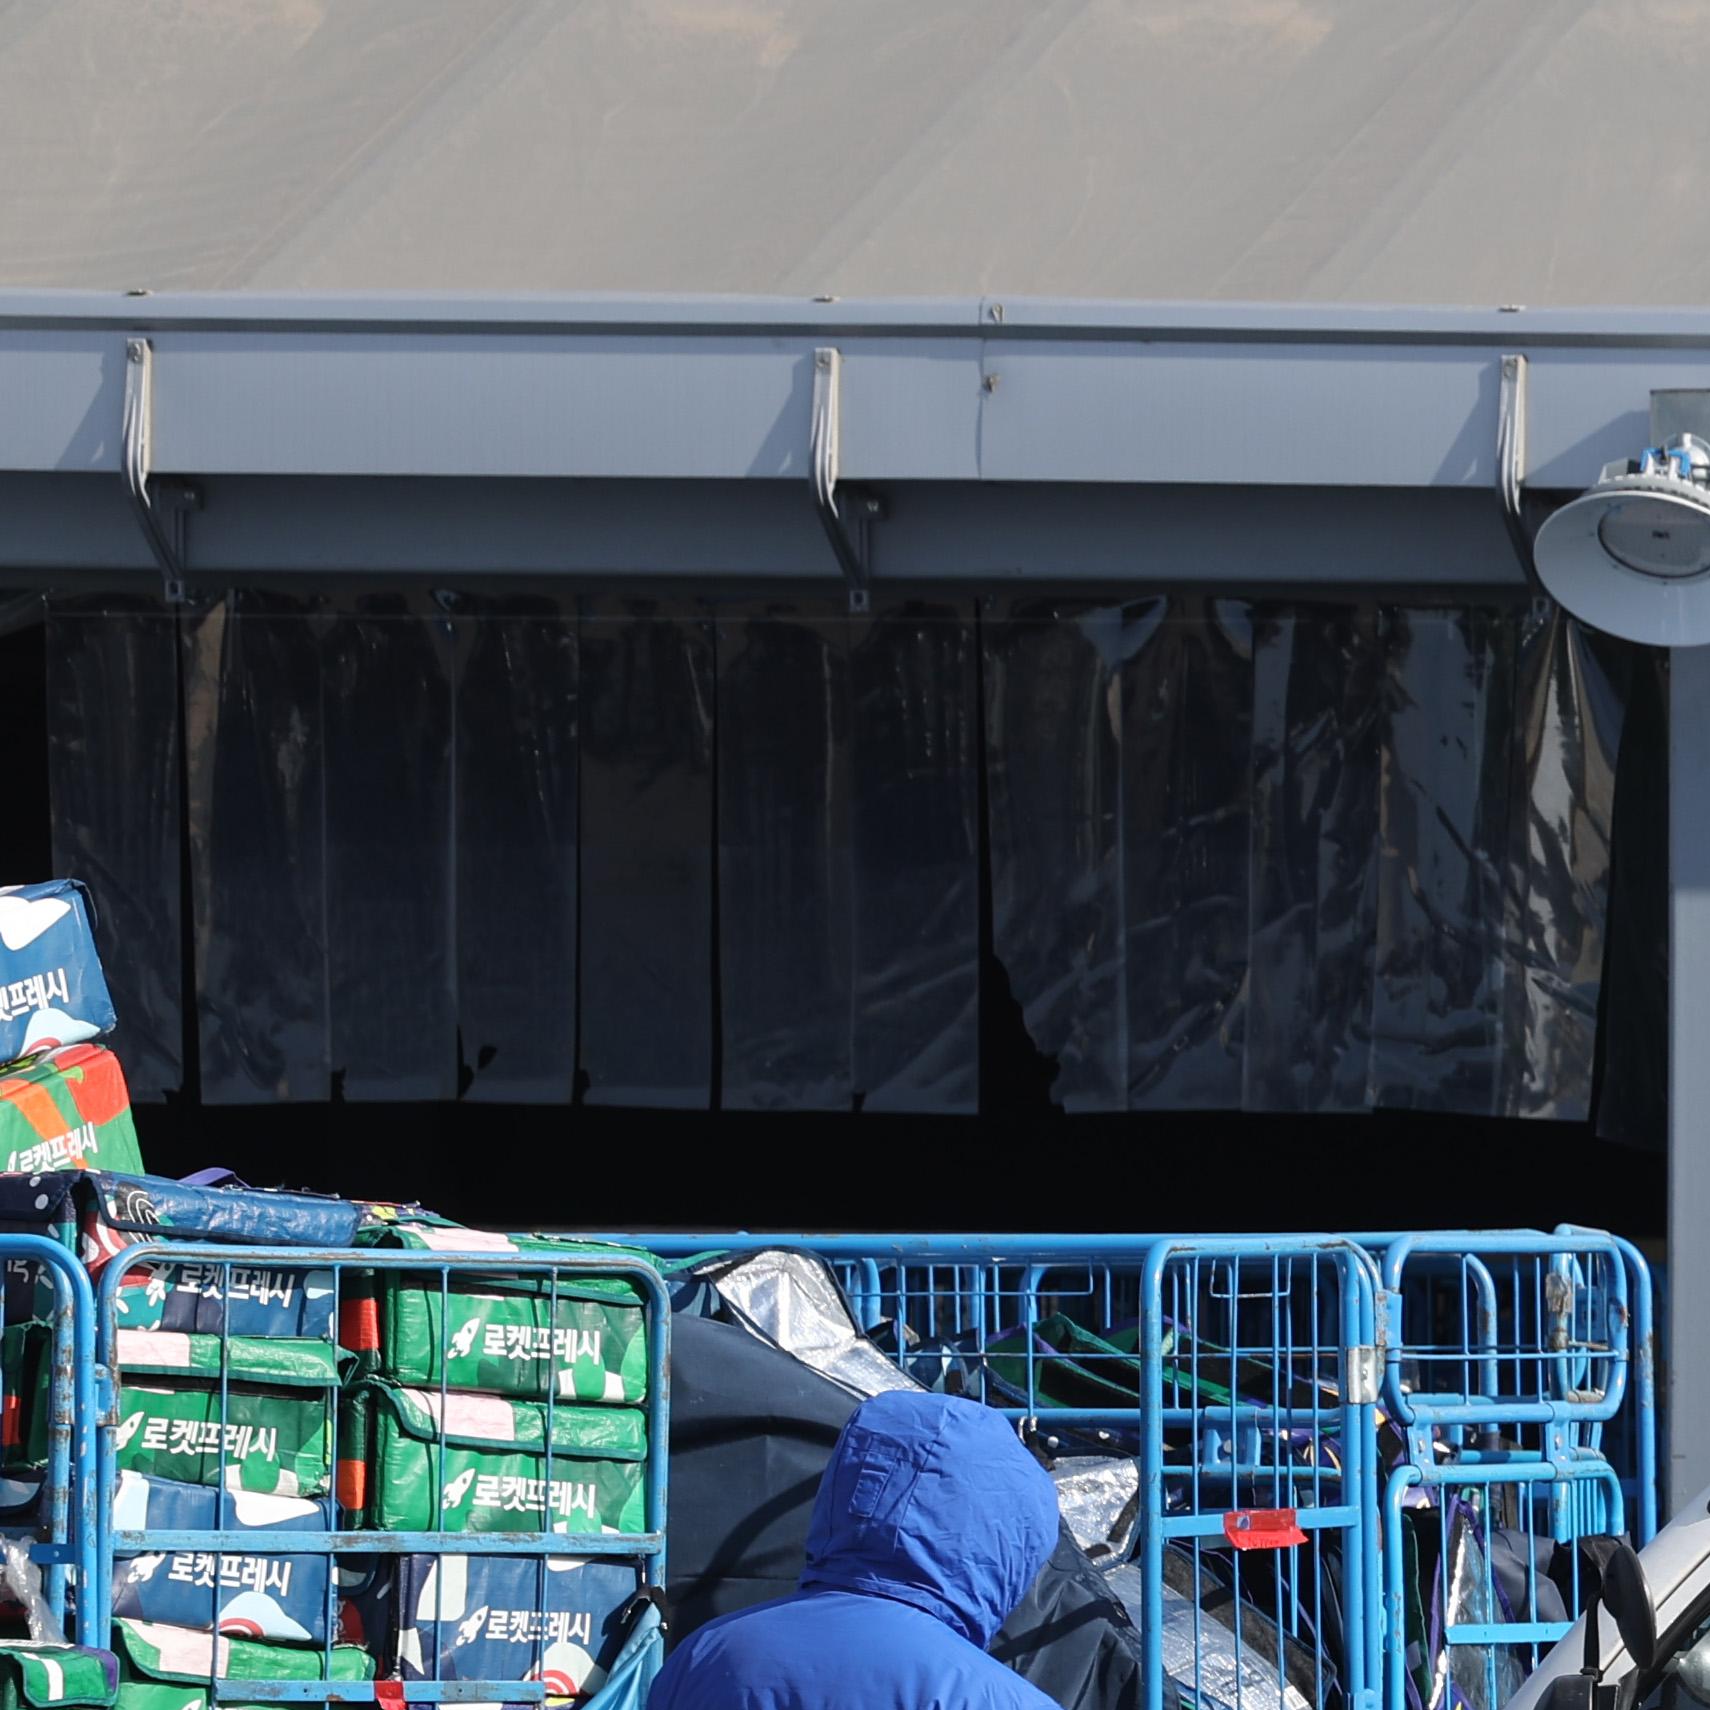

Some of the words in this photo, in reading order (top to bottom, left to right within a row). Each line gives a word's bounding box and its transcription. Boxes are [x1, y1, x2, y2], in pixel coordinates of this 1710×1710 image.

[19, 1121, 98, 1174] 로켓프레시
[176, 1262, 296, 1308] 로켓프레시
[483, 1323, 601, 1366] 로켓프레시
[141, 1416, 277, 1462] 로켓프레시
[472, 1474, 597, 1519] 로켓프레시
[168, 1552, 292, 1598] 로켓프레시
[485, 1609, 592, 1646] 로켓프레시
